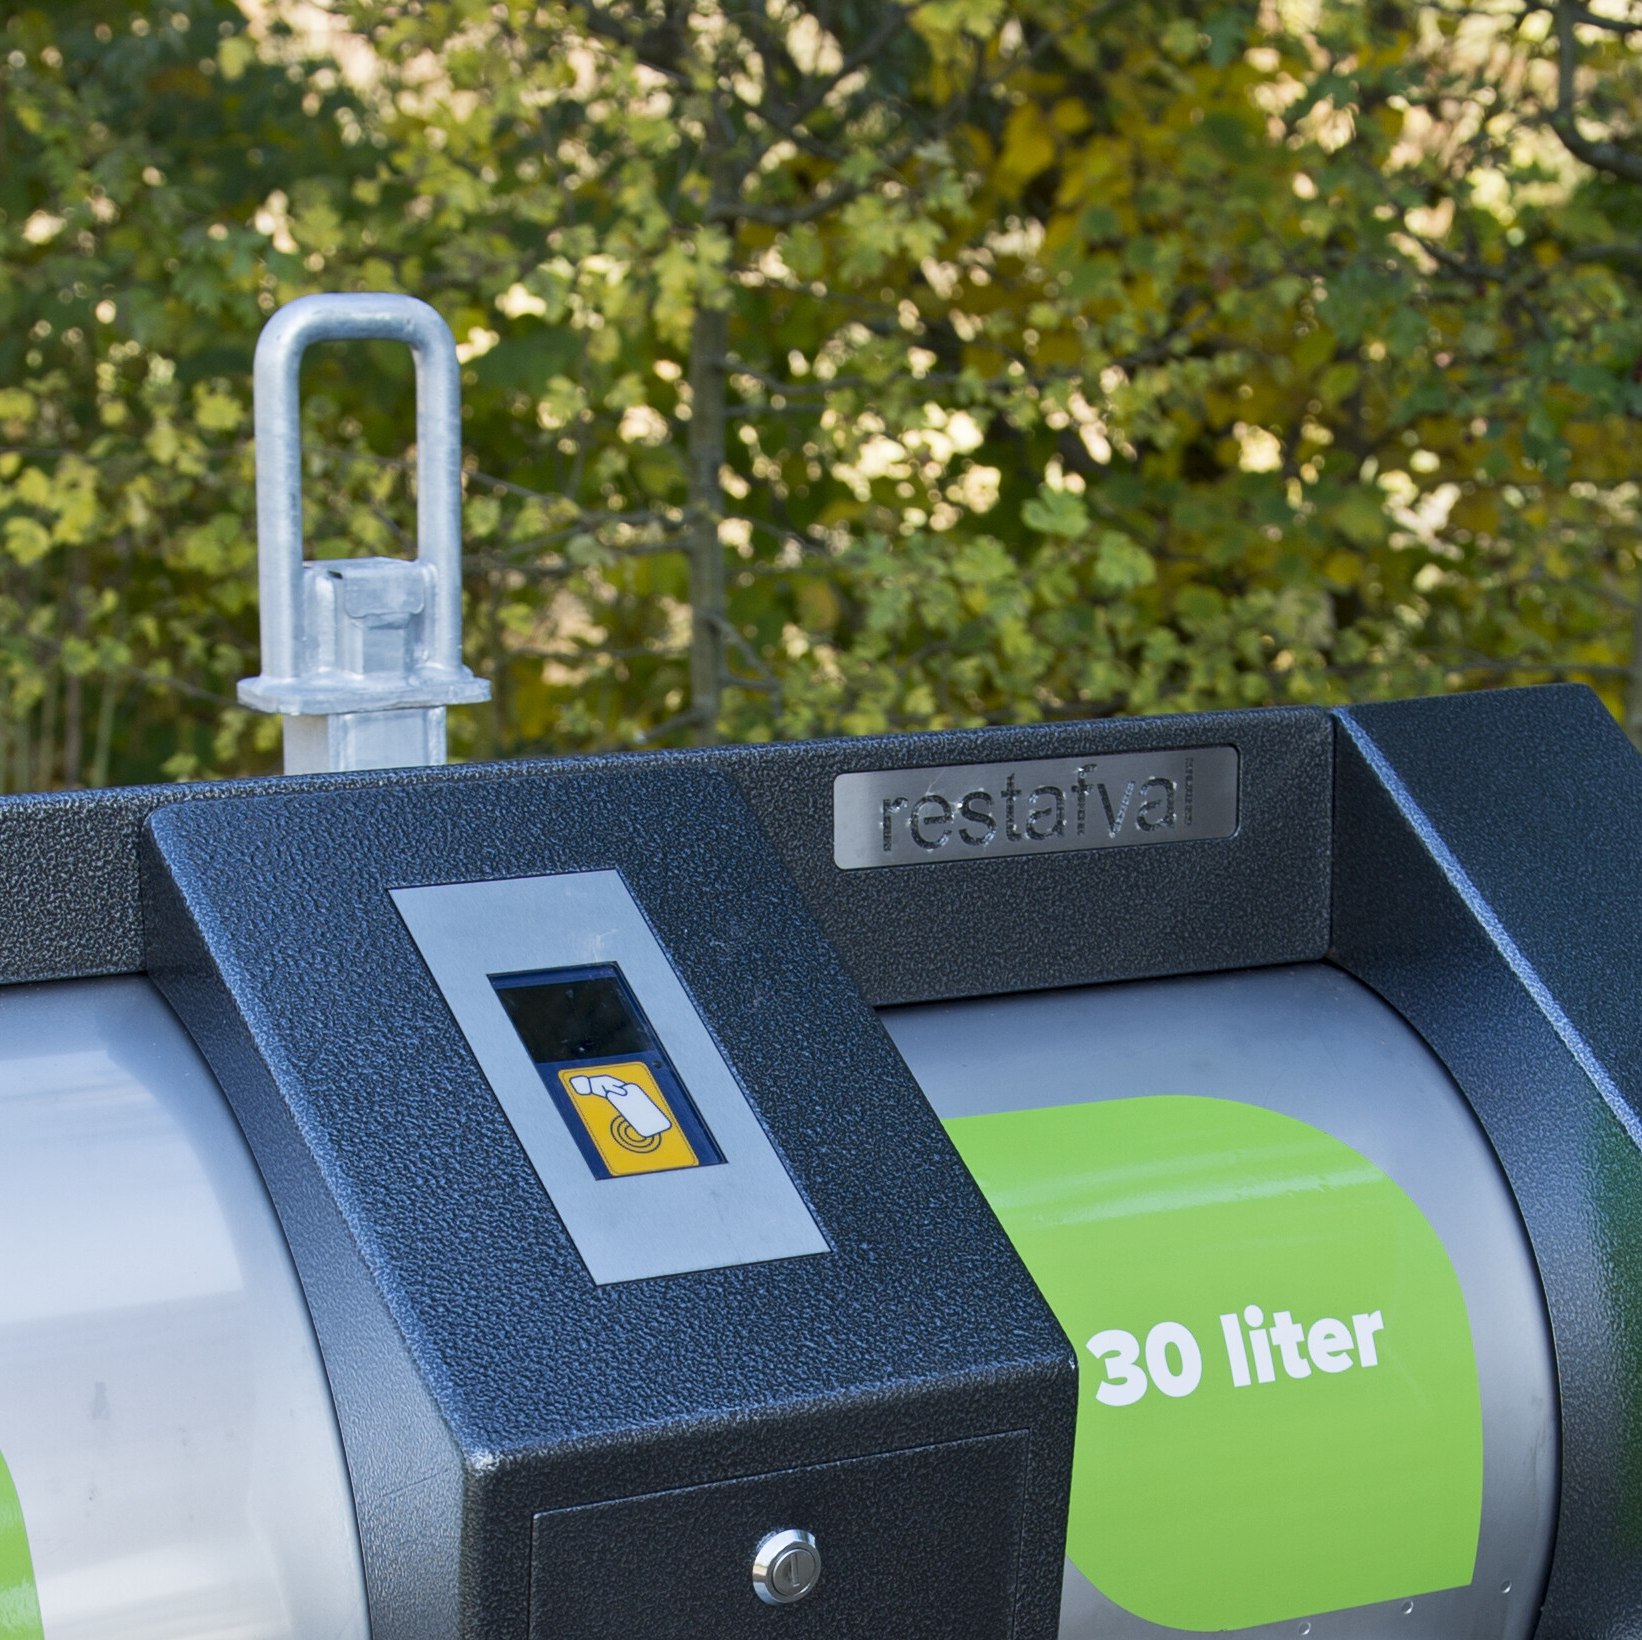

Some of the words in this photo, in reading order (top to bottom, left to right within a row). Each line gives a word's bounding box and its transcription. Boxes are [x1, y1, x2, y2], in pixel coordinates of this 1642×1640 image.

[880, 757, 1194, 852] restafval
[1085, 1321, 1202, 1406] 30
[1219, 1304, 1384, 1387] liter
